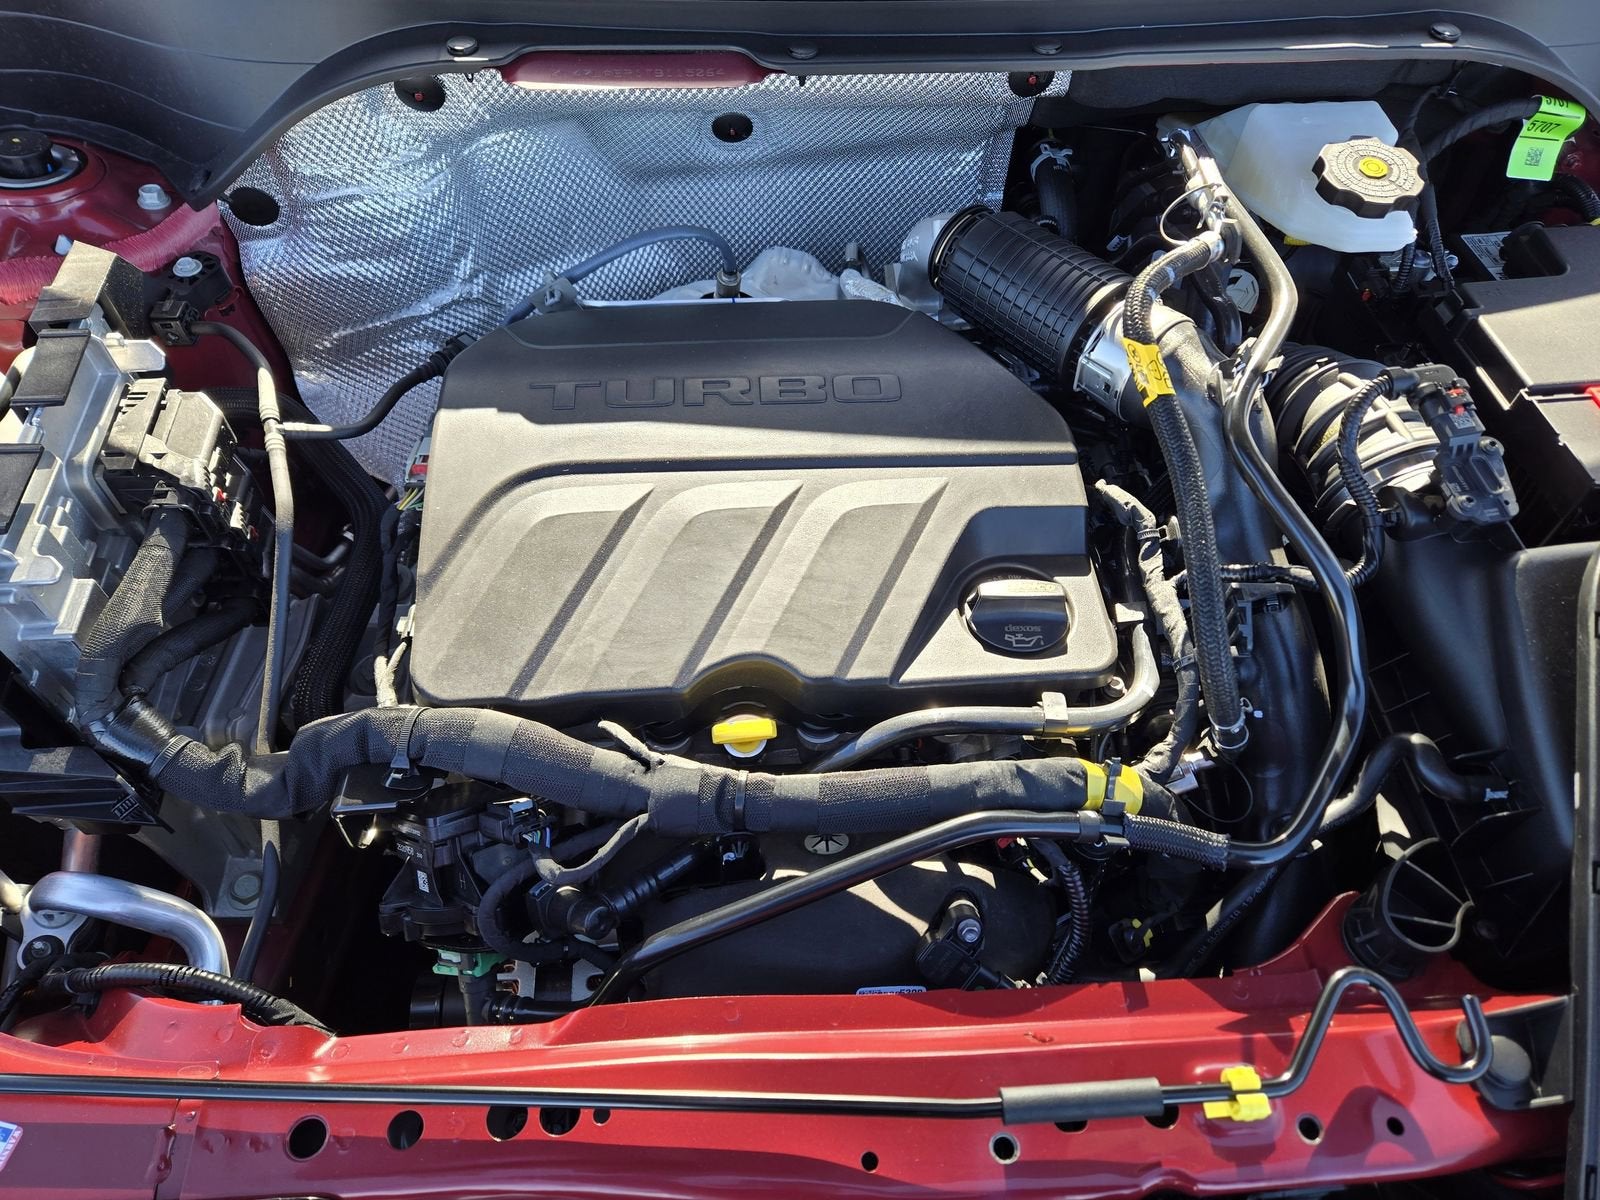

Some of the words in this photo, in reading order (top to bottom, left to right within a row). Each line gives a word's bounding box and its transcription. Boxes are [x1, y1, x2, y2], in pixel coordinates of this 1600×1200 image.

[1527, 120, 1562, 134] 5707
[529, 374, 902, 410] TURBO
[1005, 624, 1041, 632] dexos
